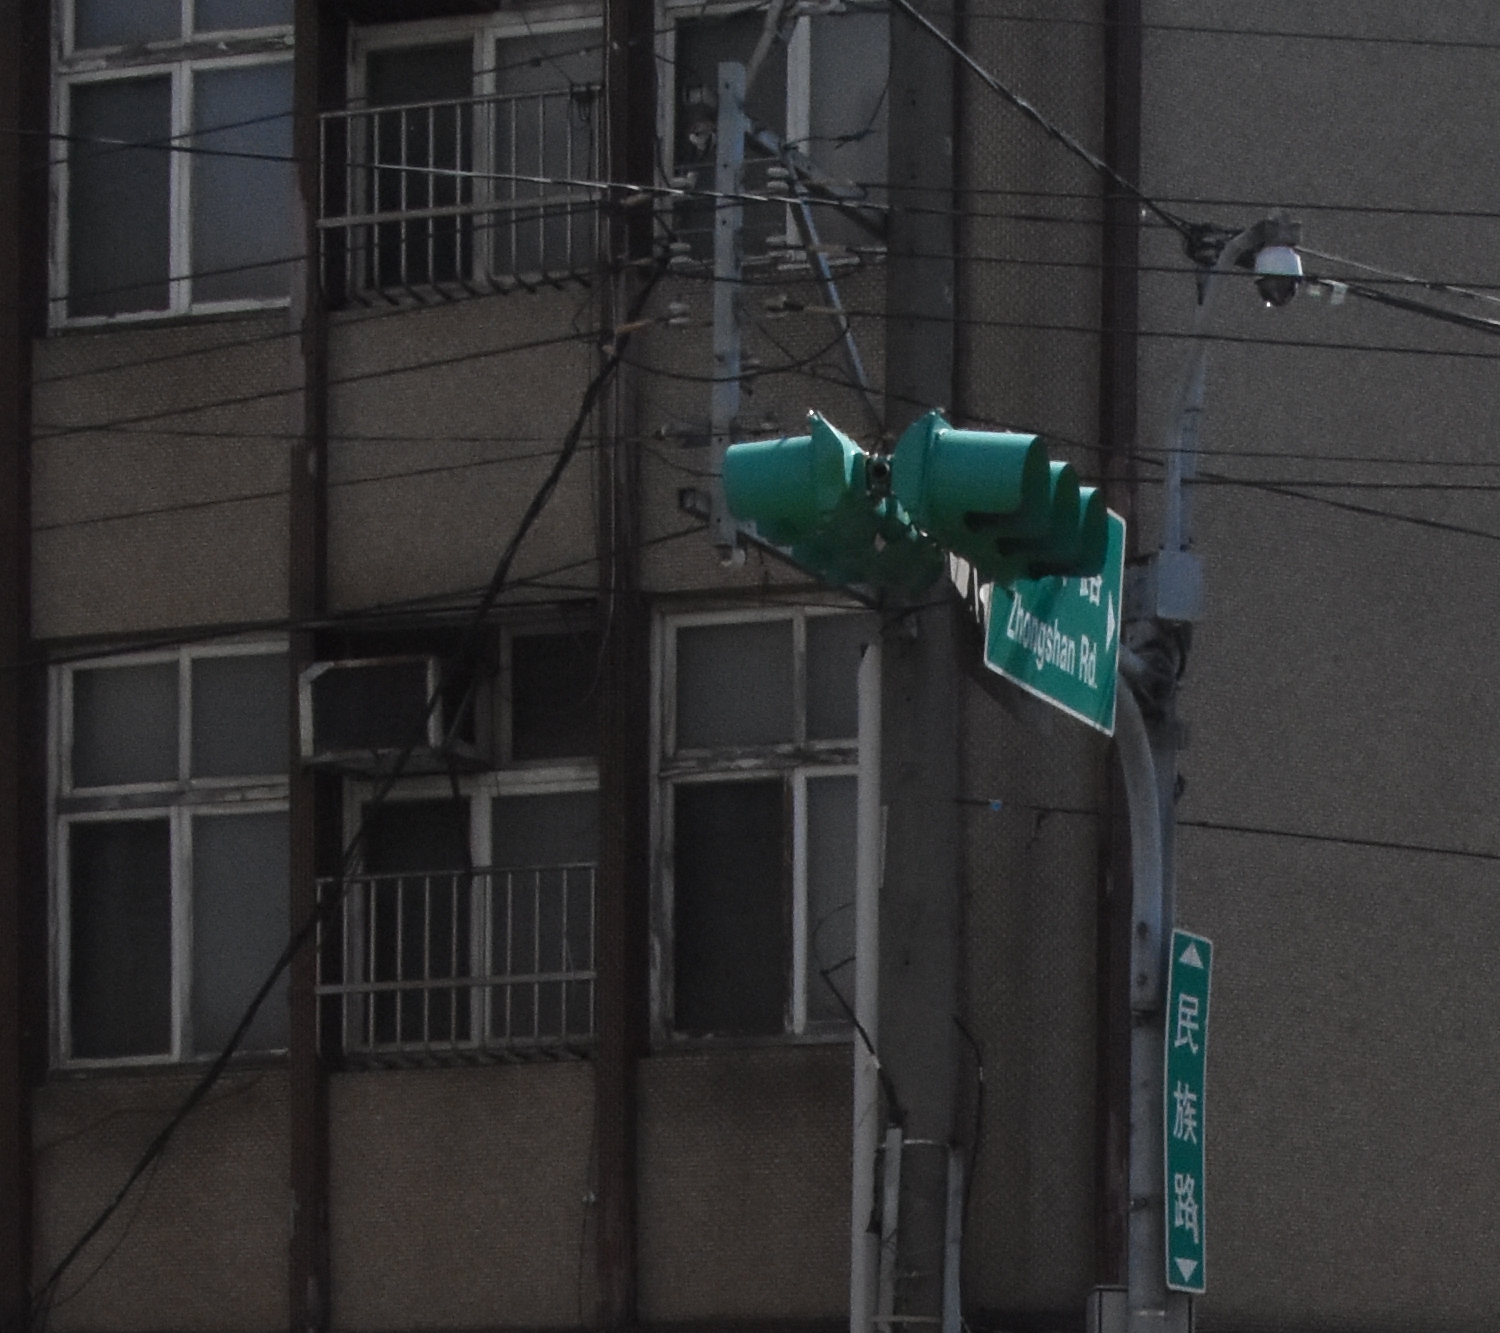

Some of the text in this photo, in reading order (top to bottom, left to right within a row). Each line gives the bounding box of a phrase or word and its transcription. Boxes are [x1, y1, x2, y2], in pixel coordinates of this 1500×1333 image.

[1006, 594, 1099, 690] Zhongshan Rd.
[1171, 992, 1200, 1245] 民族路
